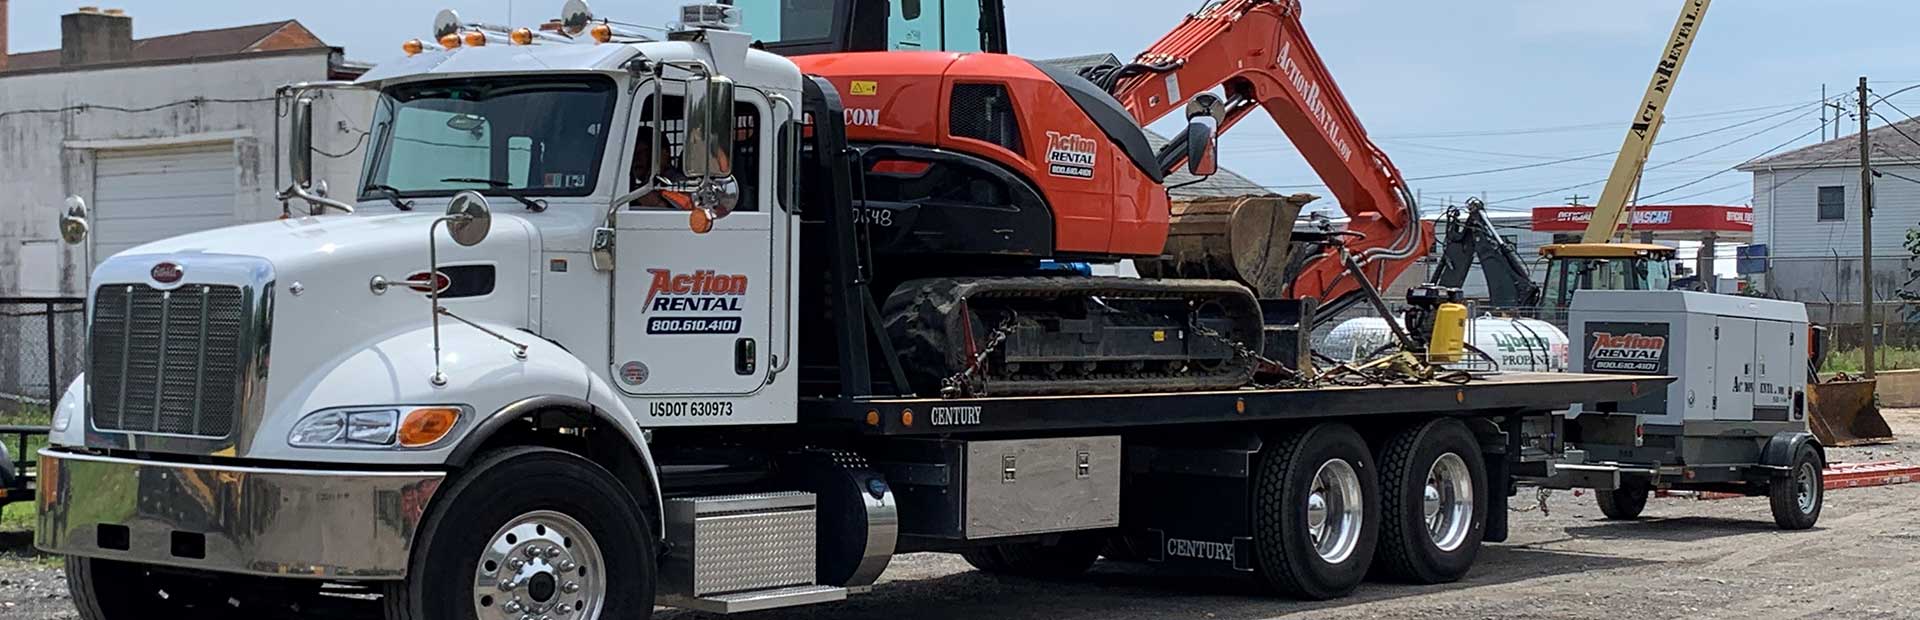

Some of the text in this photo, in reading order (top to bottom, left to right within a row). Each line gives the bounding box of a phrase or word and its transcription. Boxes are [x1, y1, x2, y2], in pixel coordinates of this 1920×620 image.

[1047, 132, 1095, 161] Action
[1051, 151, 1093, 164] RENTAL
[641, 268, 748, 313] Action
[652, 297, 742, 312] RENTAL
[651, 319, 737, 331] 800.610.4101
[1589, 332, 1663, 358] Action
[1597, 350, 1659, 360] RENTAL
[650, 402, 733, 416] USDOT 630973
[931, 406, 982, 425] CENTURY
[1167, 538, 1234, 561] CENTURY
